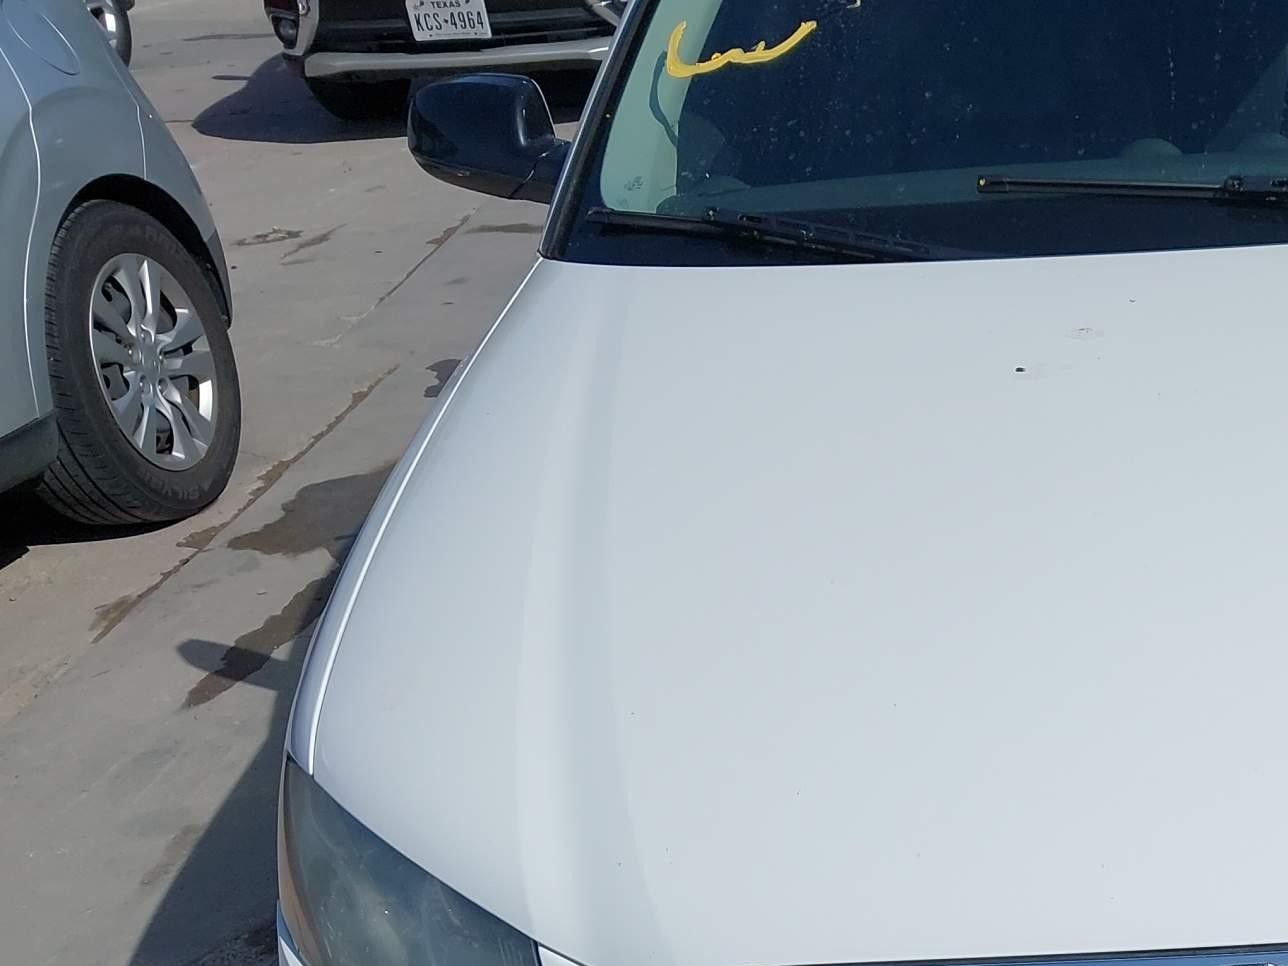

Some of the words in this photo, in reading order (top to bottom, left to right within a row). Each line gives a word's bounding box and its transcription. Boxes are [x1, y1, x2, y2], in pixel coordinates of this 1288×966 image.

[430, 0, 461, 9] TEXAS
[414, 12, 442, 31] KCS
[449, 11, 484, 30] 4964
